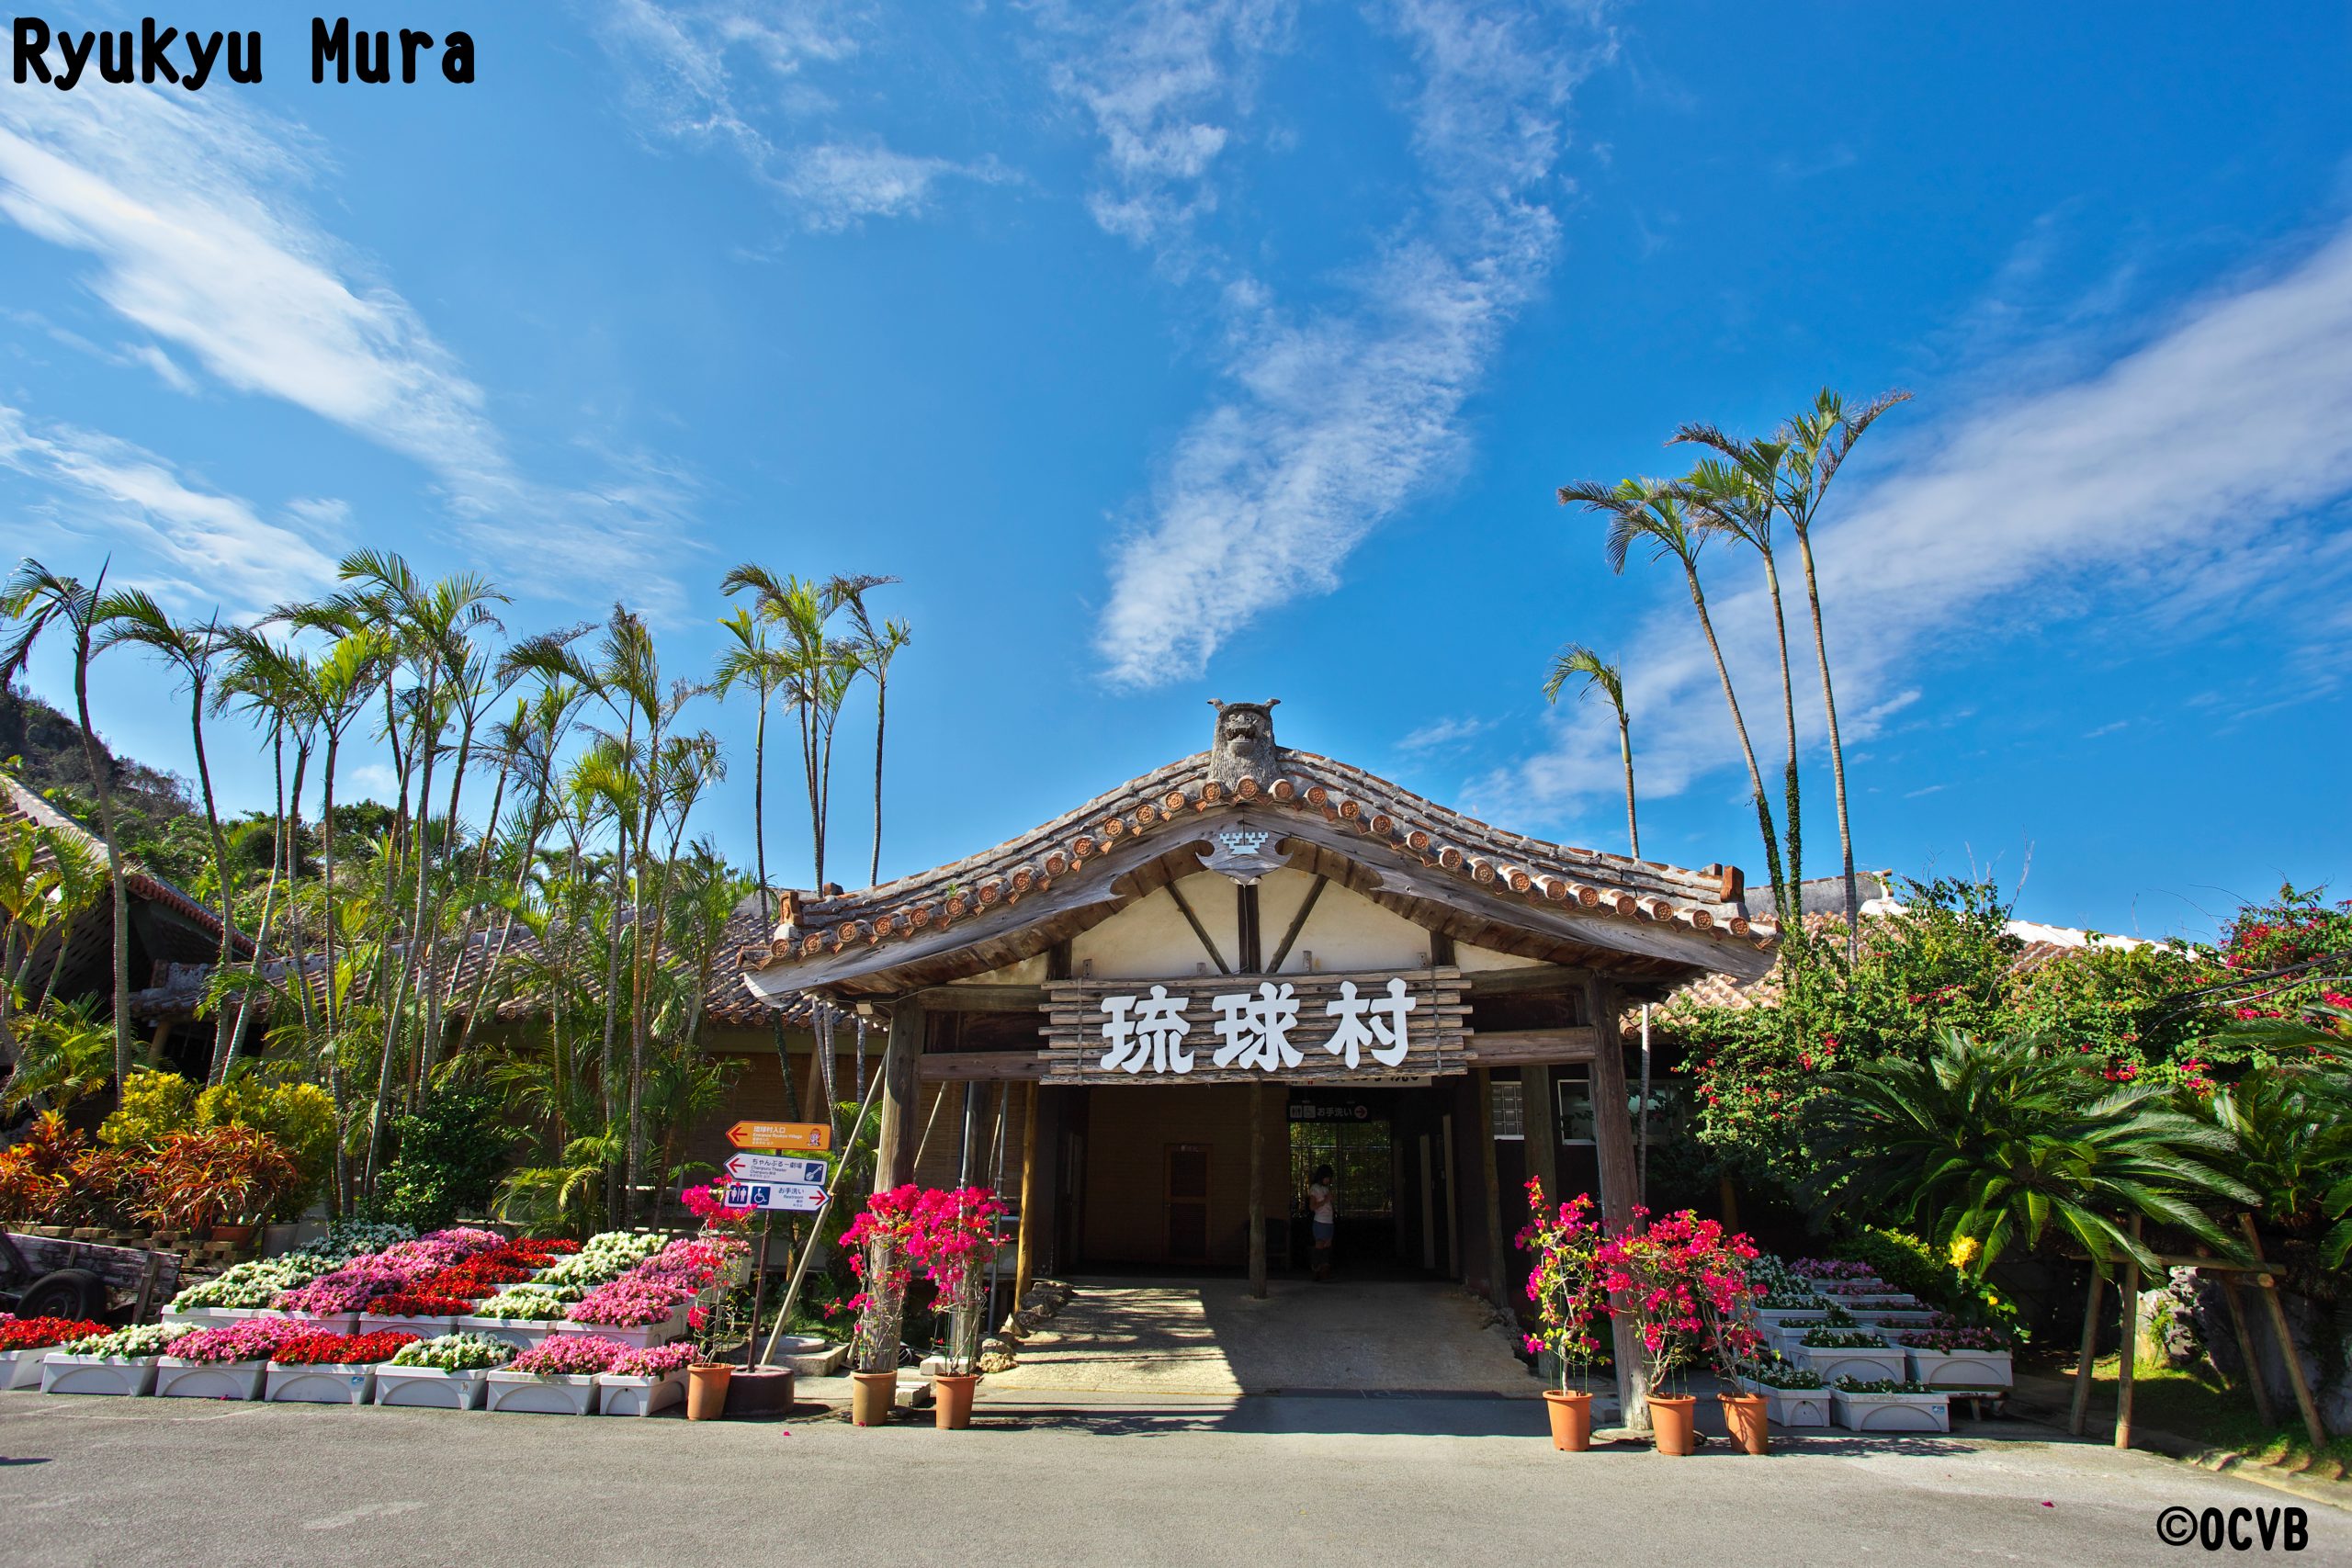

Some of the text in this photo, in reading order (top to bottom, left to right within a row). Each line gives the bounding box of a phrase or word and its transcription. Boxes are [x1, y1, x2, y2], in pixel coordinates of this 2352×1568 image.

[1100, 977, 1417, 1075] 琉球村
[1317, 1107, 1352, 1117] お手洗い
[778, 1187, 805, 1195] お手洗い
